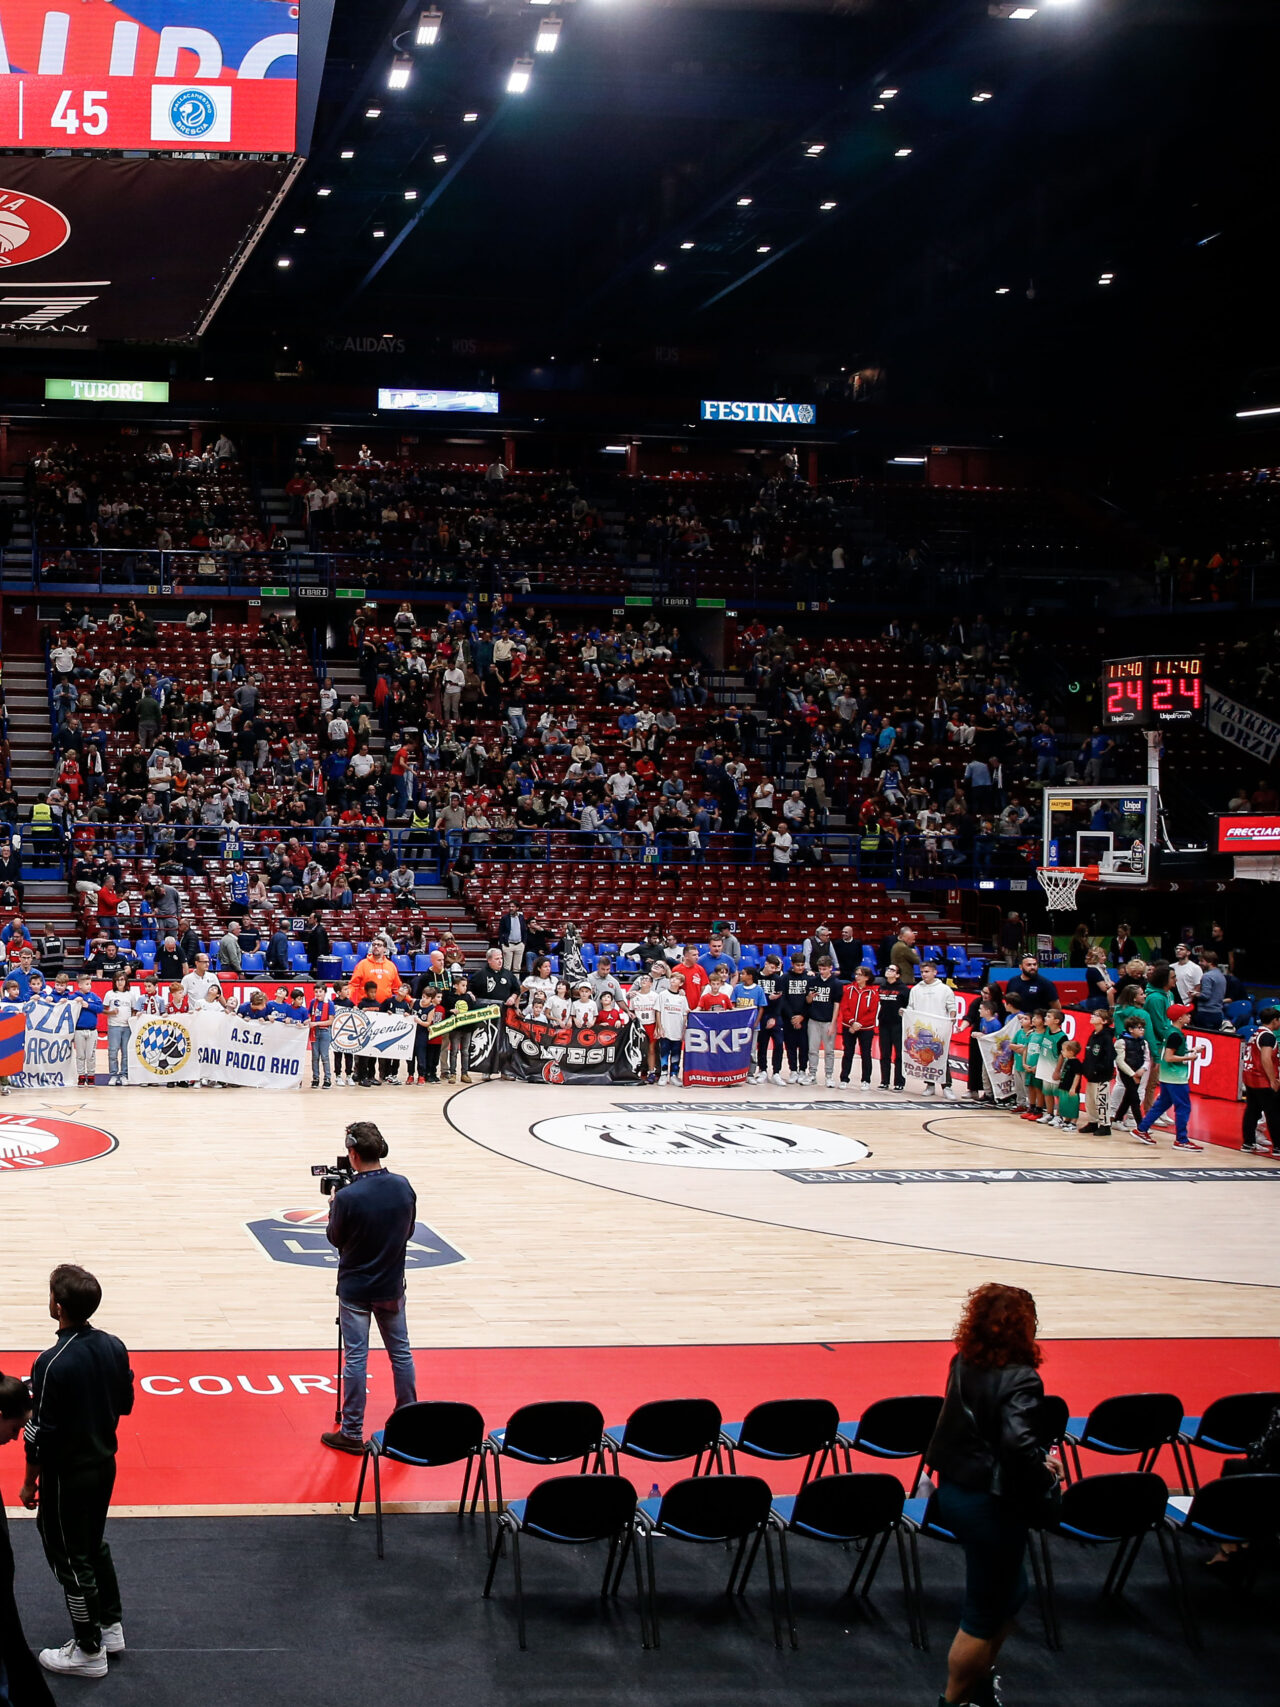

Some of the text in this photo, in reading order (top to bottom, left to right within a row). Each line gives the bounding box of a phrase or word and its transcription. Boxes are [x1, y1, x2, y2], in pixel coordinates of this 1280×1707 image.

[50, 90, 108, 136] 45
[174, 121, 209, 135] BRESCIA
[71, 380, 144, 401] TUBORG
[703, 401, 797, 423] FESTINA
[1110, 662, 1142, 678] 11:40
[1156, 660, 1200, 675] 11:40
[1107, 680, 1143, 713] 24
[1152, 678, 1200, 710] 24
[1123, 800, 1142, 812] Unipol
[788, 979, 807, 987] EBRO
[231, 1027, 264, 1046] A.S.D.
[348, 1020, 409, 1044] Argentia
[576, 1028, 618, 1047] GO
[685, 1027, 753, 1054] BKP
[198, 1046, 299, 1076] SAN PAOLO RHO
[629, 1103, 766, 1112] EMPORIO
[809, 1102, 932, 1110] ARMANI
[584, 1123, 707, 1134] ACQUA
[628, 1147, 826, 1156] GIORGIO ARMANI
[794, 1170, 964, 1183] EMPORIO
[1018, 1168, 1165, 1180] ARMANI
